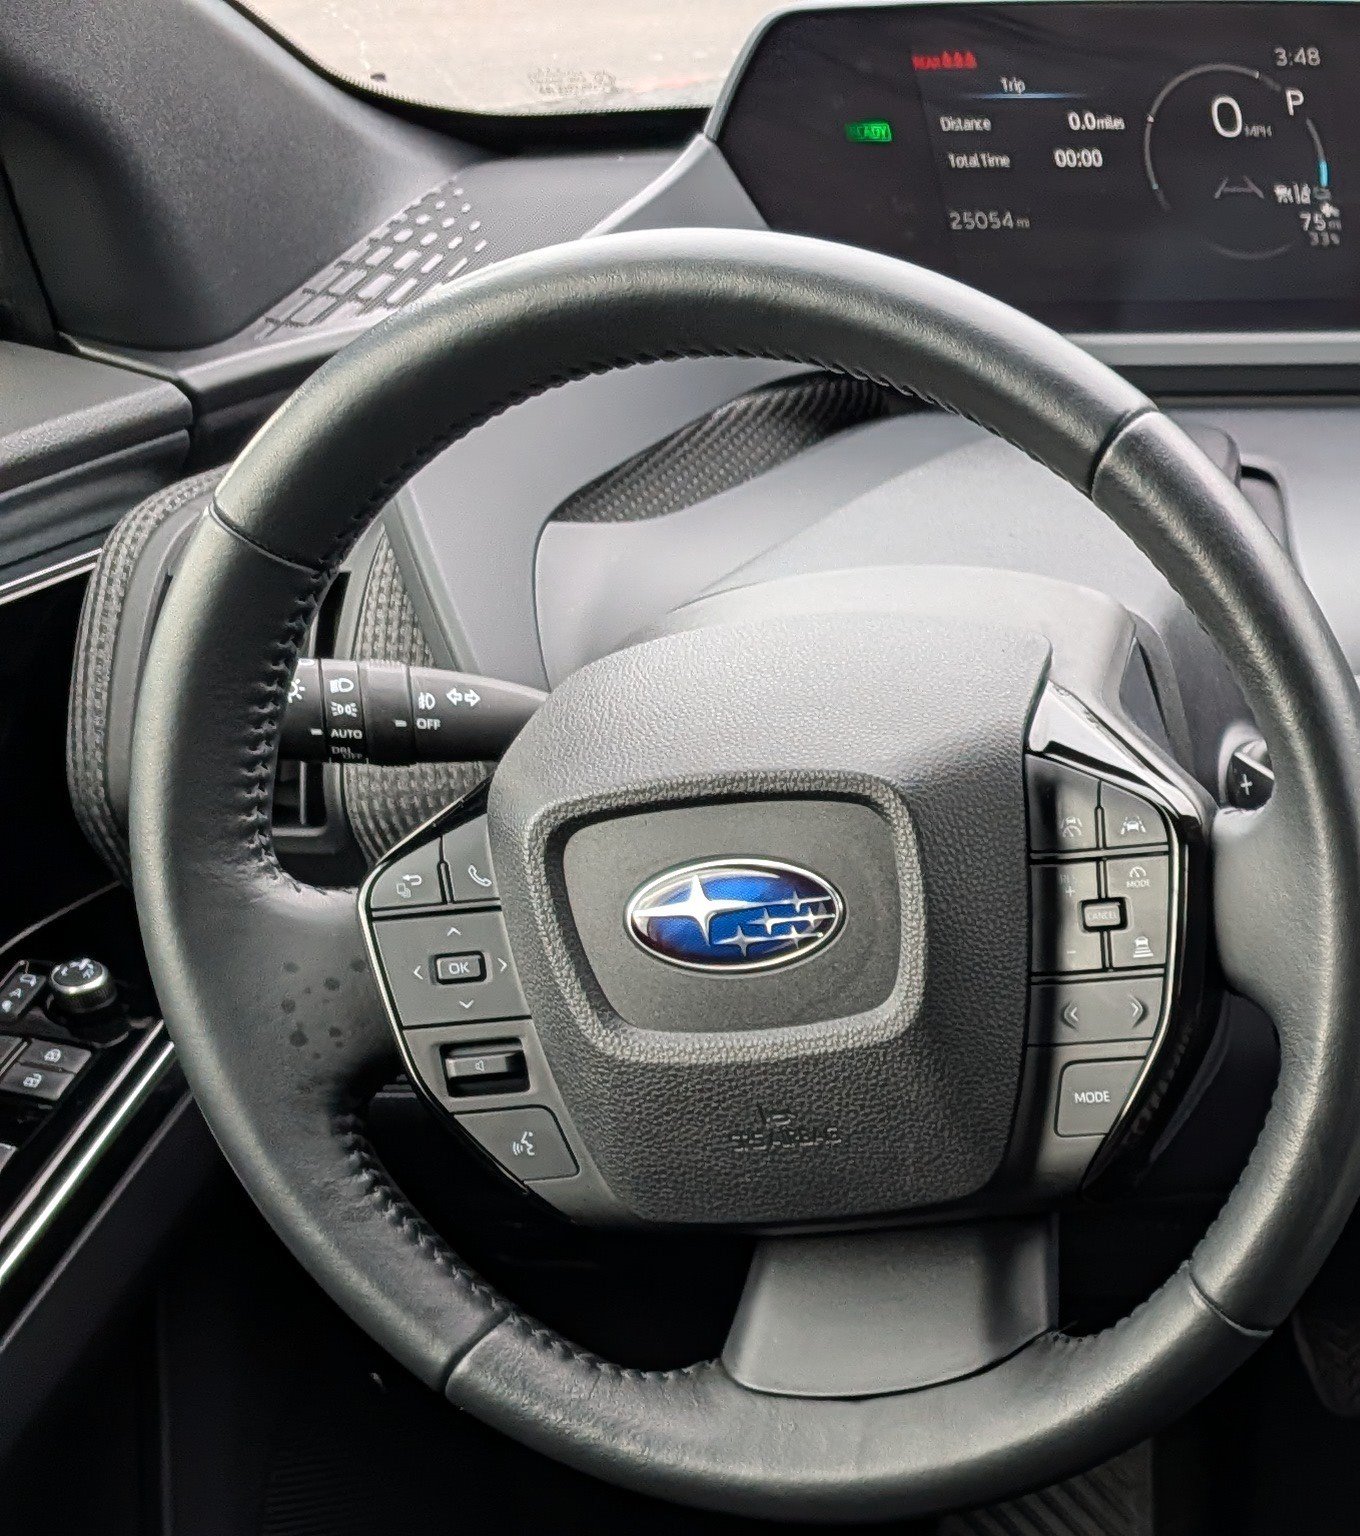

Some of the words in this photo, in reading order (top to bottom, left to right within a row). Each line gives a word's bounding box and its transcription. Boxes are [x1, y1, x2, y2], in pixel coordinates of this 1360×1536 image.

[1274, 47, 1321, 67] 3:48
[1001, 77, 1026, 94] Trip
[1284, 87, 1304, 116] P
[940, 116, 992, 132] Distance
[1211, 95, 1242, 138] 0
[1053, 149, 1103, 168] 00:00
[950, 211, 1015, 231] 25054
[1300, 211, 1326, 232] 75
[416, 718, 442, 731] OFF
[330, 728, 363, 740] AUTO
[448, 961, 470, 975] OK
[1074, 1090, 1110, 1104] MODE
